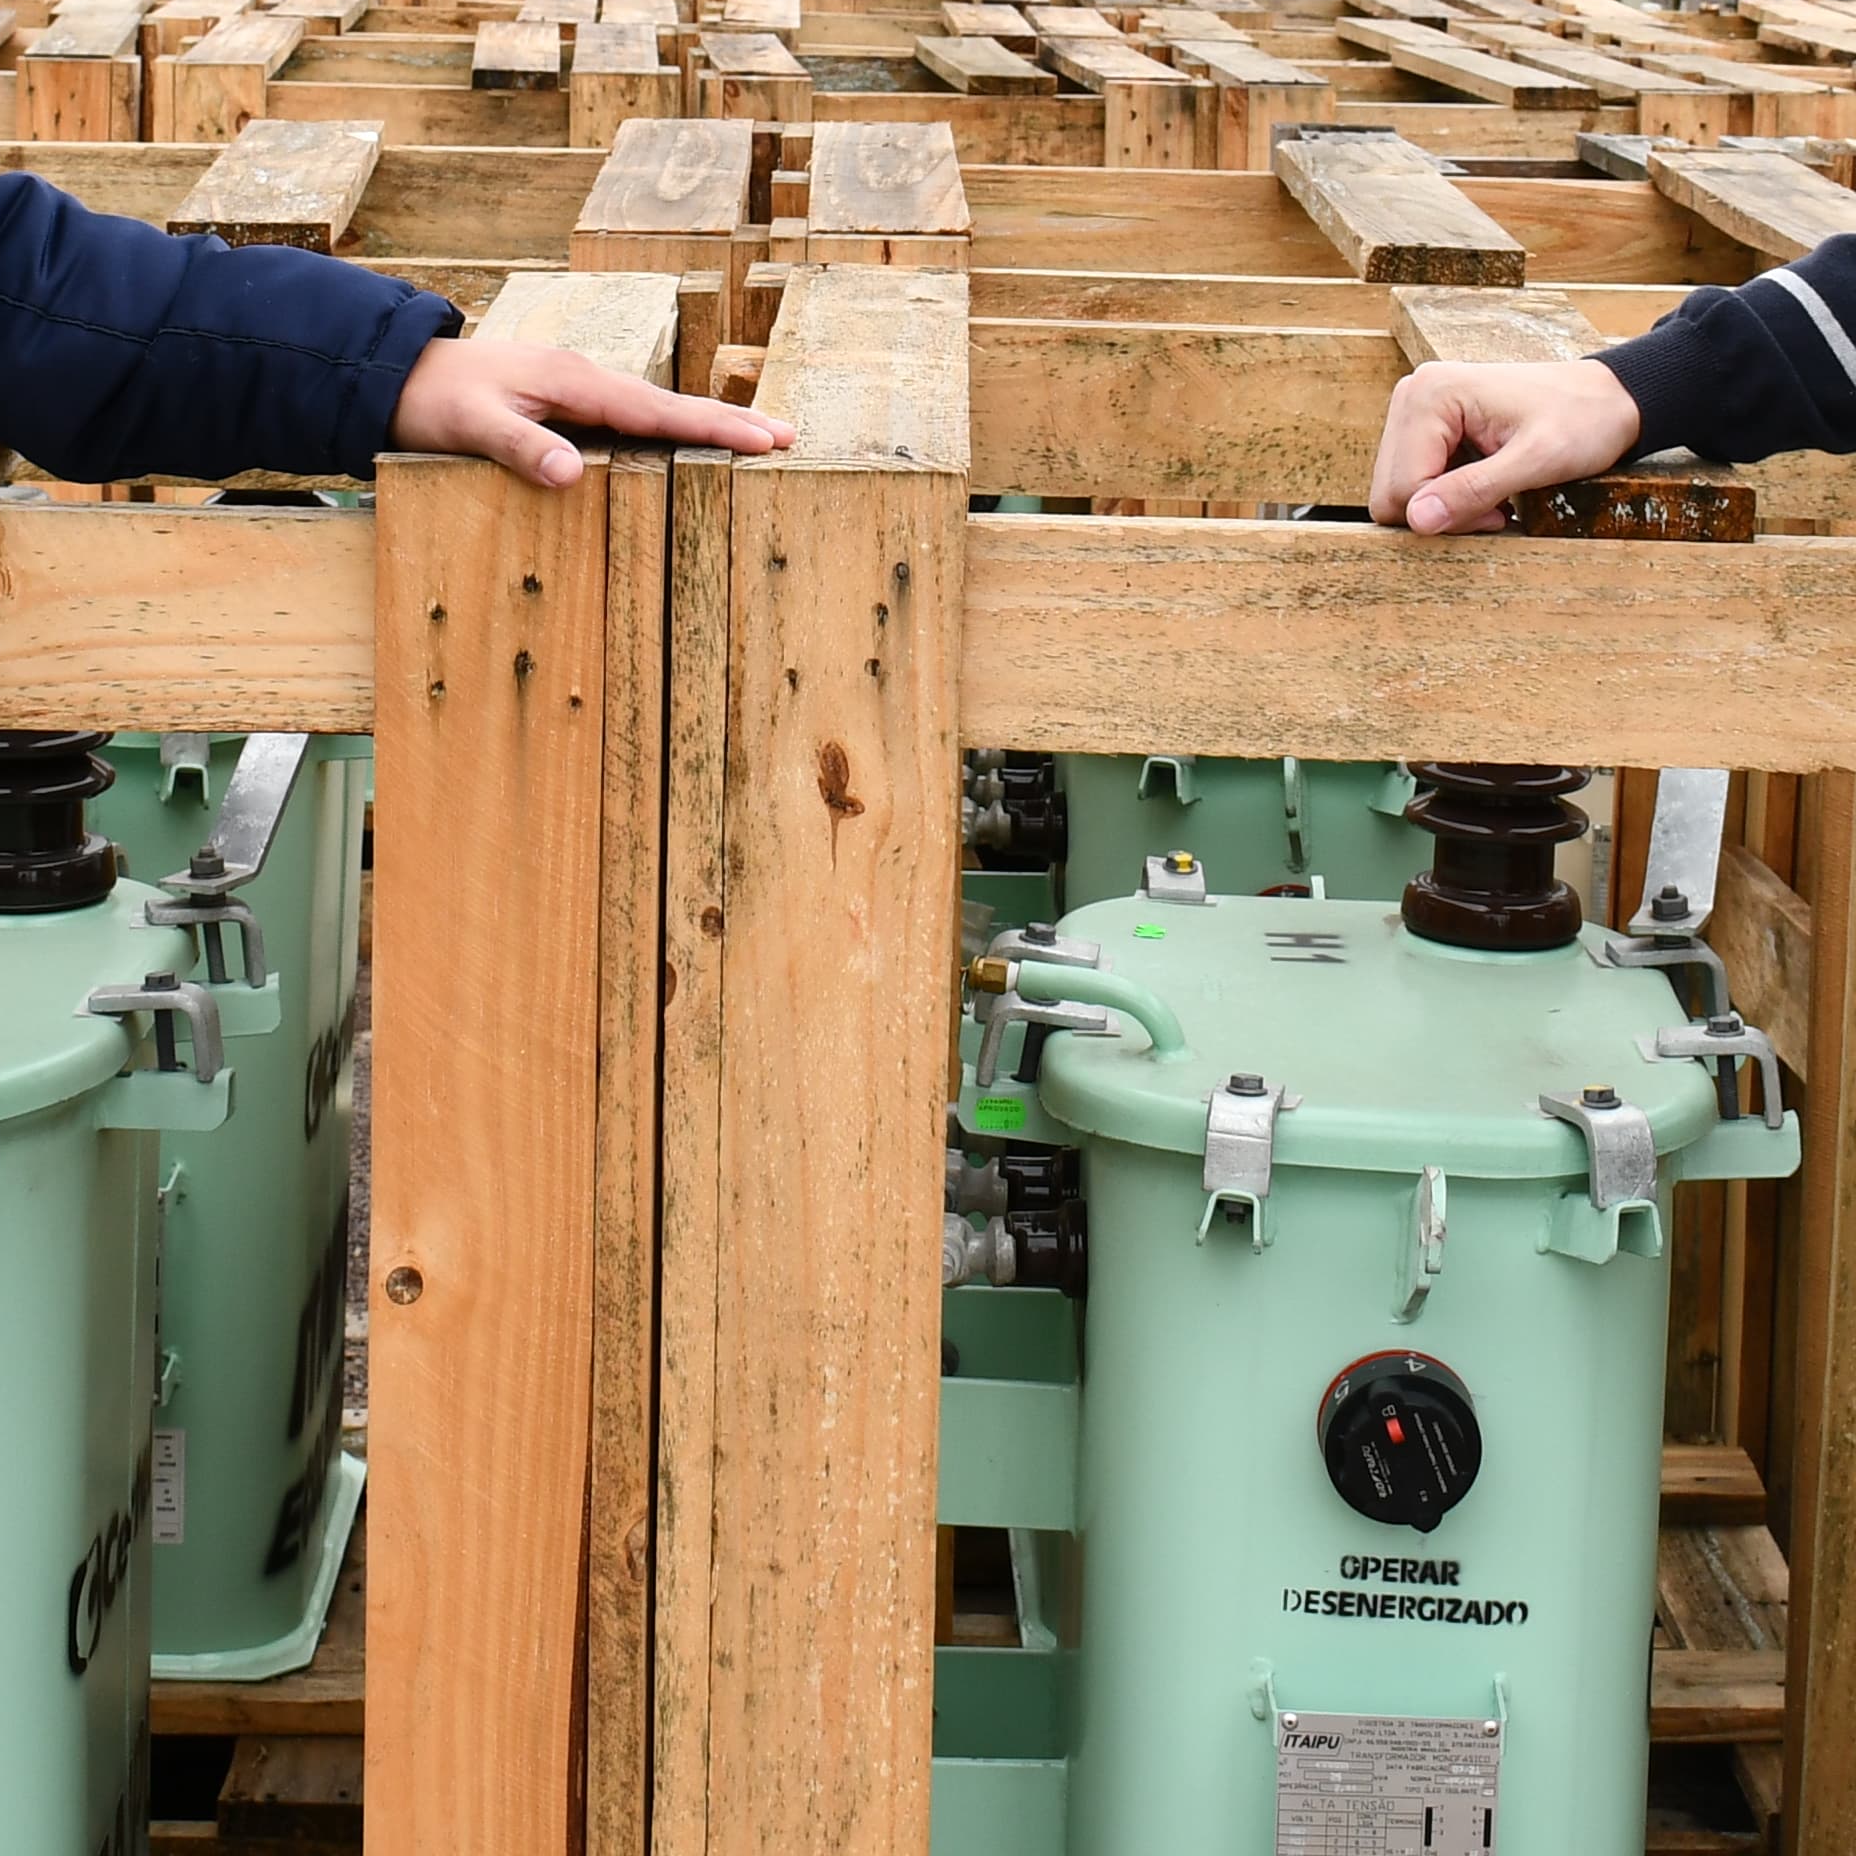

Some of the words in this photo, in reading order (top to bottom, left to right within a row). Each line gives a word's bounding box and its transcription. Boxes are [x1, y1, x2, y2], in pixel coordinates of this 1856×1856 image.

[1404, 1357, 1427, 1373] 4
[1340, 1555, 1461, 1586] OPERAR
[1282, 1588, 1528, 1625] DESENERGIZADO
[1283, 1734, 1340, 1749] ITAIPU
[1302, 1799, 1335, 1809] ALTA
